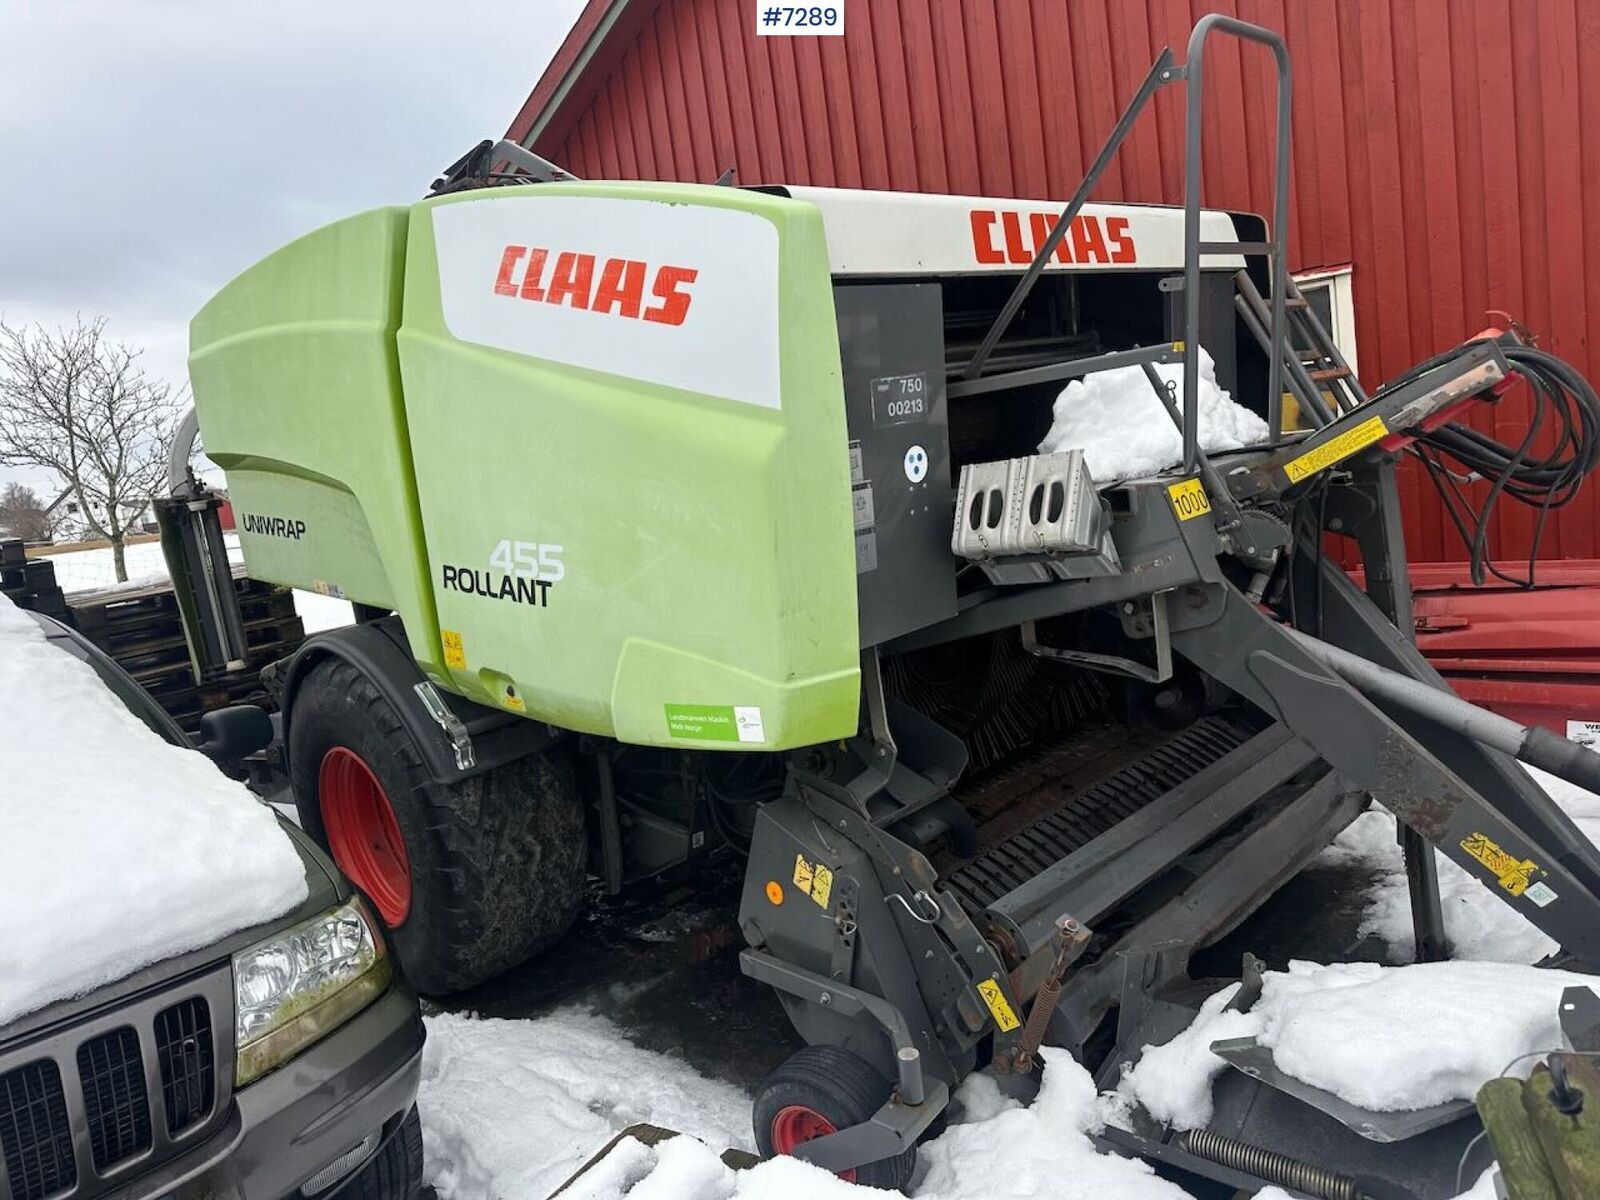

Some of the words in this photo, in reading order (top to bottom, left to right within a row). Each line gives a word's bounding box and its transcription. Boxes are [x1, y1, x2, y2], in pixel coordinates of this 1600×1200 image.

[494, 245, 699, 326] CLAAS
[900, 378, 922, 393] 750
[888, 399, 923, 417] 00213
[1175, 490, 1208, 515] 1000
[242, 513, 306, 540] UNIWRAP
[489, 539, 565, 582] 455
[443, 564, 552, 607] ROLLANT
